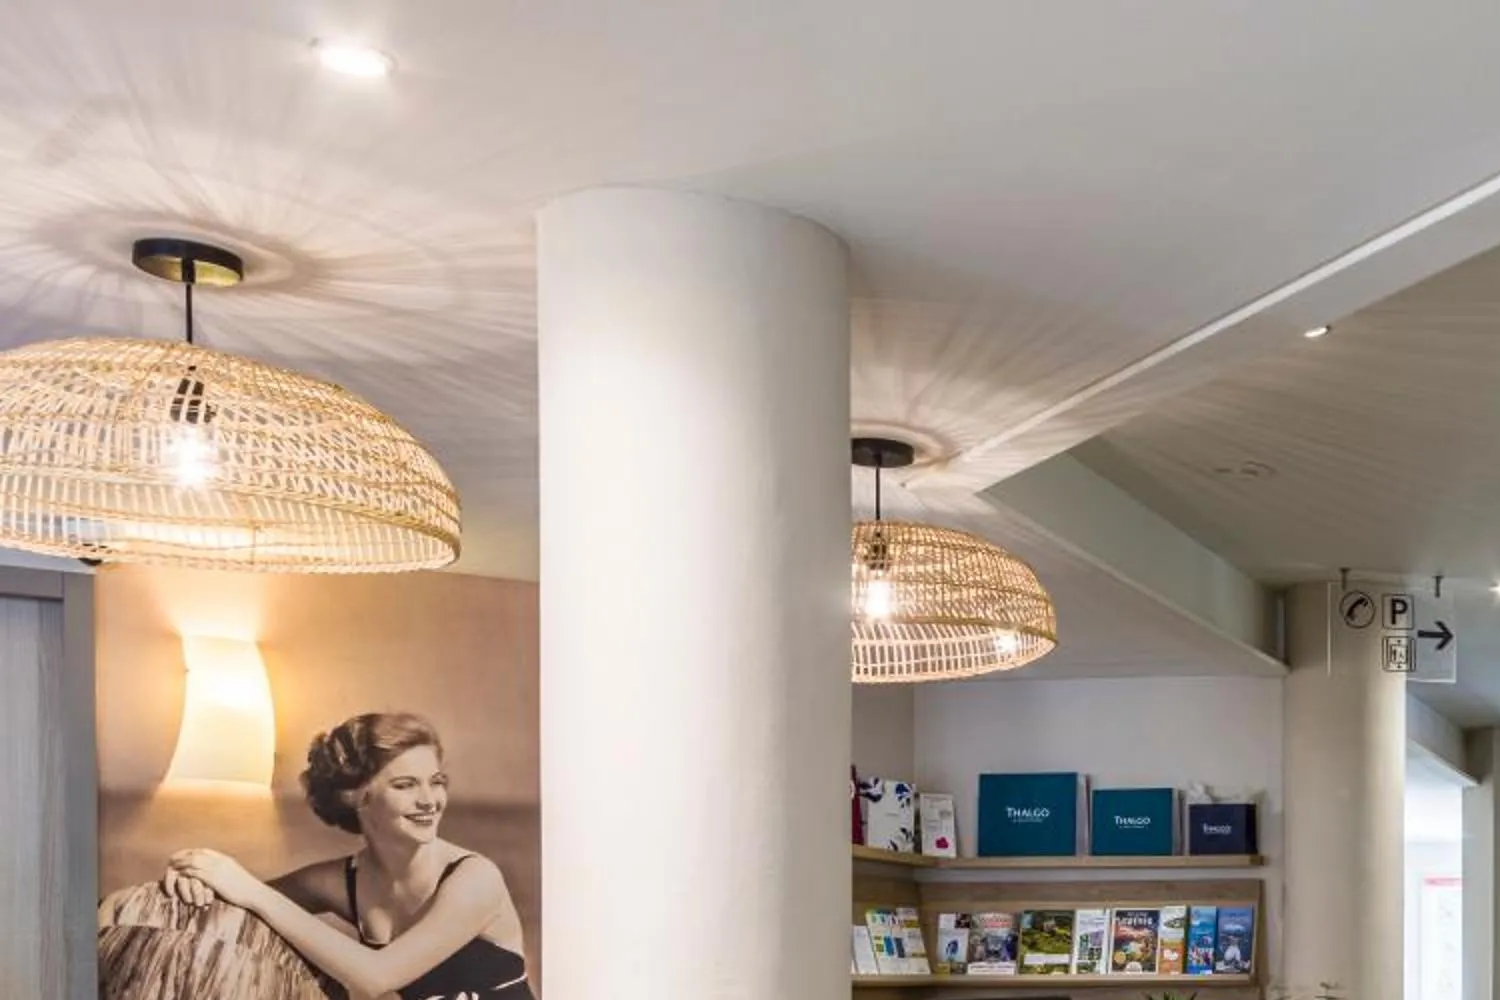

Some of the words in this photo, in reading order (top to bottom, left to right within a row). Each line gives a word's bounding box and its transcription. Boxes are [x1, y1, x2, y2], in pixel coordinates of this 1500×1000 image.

[1391, 598, 1408, 625] P
[1007, 807, 1050, 818] THALGO
[1114, 815, 1151, 825] THALGO
